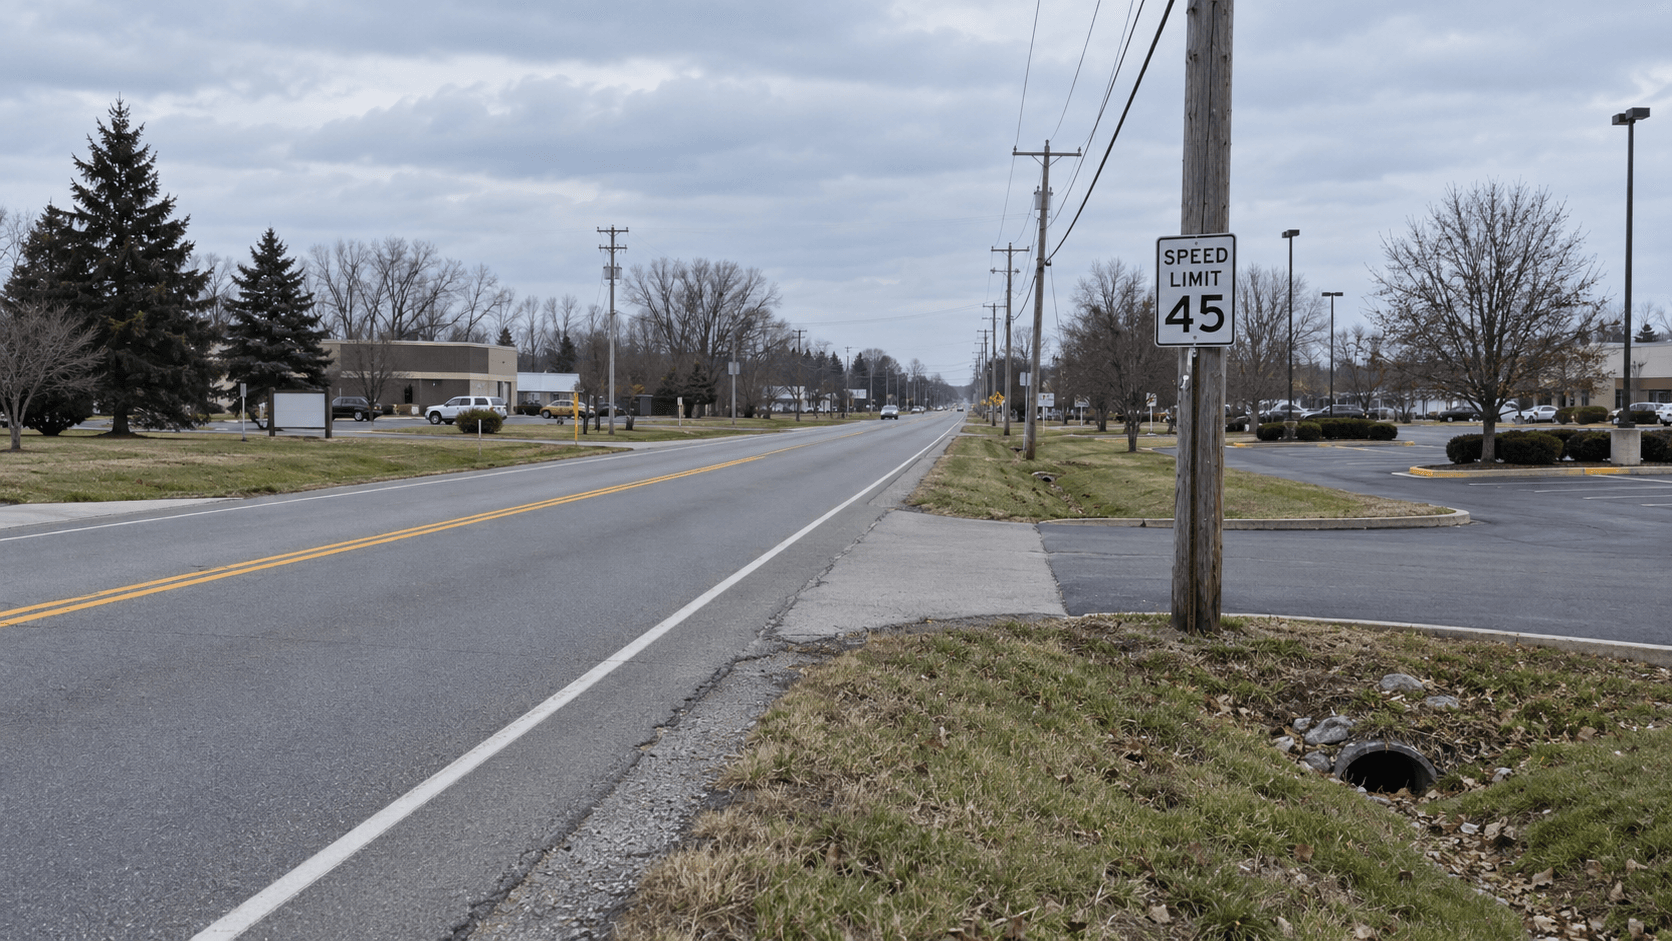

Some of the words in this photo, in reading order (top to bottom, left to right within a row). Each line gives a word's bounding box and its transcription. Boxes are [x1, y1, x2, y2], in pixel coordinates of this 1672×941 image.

[1164, 247, 1228, 265] SPEED
[1170, 270, 1222, 287] LIMIT
[1165, 294, 1225, 333] 45
